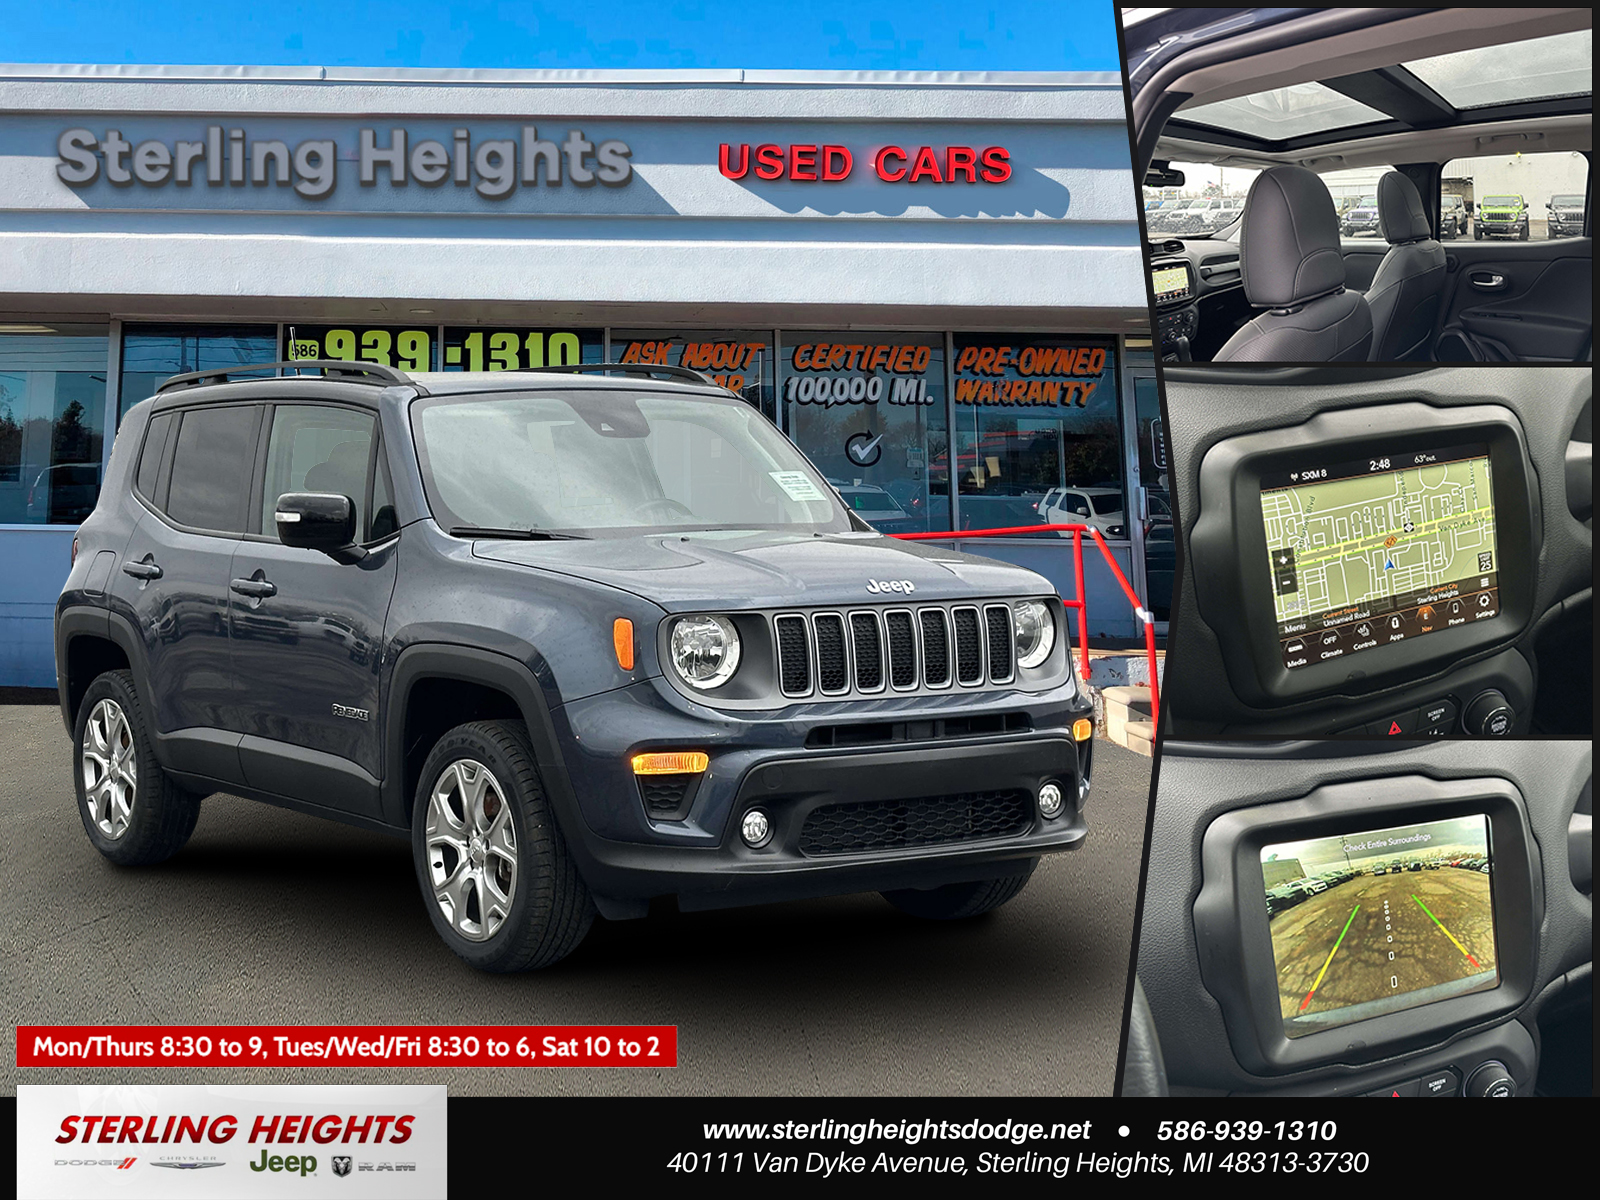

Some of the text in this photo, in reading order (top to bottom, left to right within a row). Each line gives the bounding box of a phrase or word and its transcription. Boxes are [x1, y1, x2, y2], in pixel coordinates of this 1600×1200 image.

[55, 125, 635, 200] Sterling Heights
[718, 143, 1012, 184] USED CARS
[292, 344, 317, 358] 586
[325, 329, 430, 373] 939
[621, 341, 766, 370] ASK ABOUT
[792, 342, 932, 373] CERTIFIED
[955, 346, 1107, 377] PRE-OWNED
[786, 376, 934, 408] 100,000 MI.
[955, 379, 1097, 407] WARRANTY
[1369, 458, 1391, 471] 2:48
[1301, 468, 1328, 481] SXM 8
[1306, 495, 1316, 514] Blvd
[1480, 560, 1492, 571] 25
[866, 578, 916, 596] Jeep
[1417, 590, 1459, 605] Sterling Heights
[1322, 610, 1343, 620] Current
[1323, 610, 1371, 628] Unnamed Road
[1448, 617, 1466, 626] Phone
[1475, 609, 1496, 620] Settings
[1284, 623, 1307, 634] Menu
[1421, 625, 1433, 633] Nav
[1323, 635, 1337, 645] OFF
[1389, 633, 1405, 642] Apps
[1353, 639, 1378, 651] Controls
[1320, 648, 1344, 660] Climate
[1287, 658, 1307, 669] Media
[1343, 833, 1432, 853] Check Entire Surroundings
